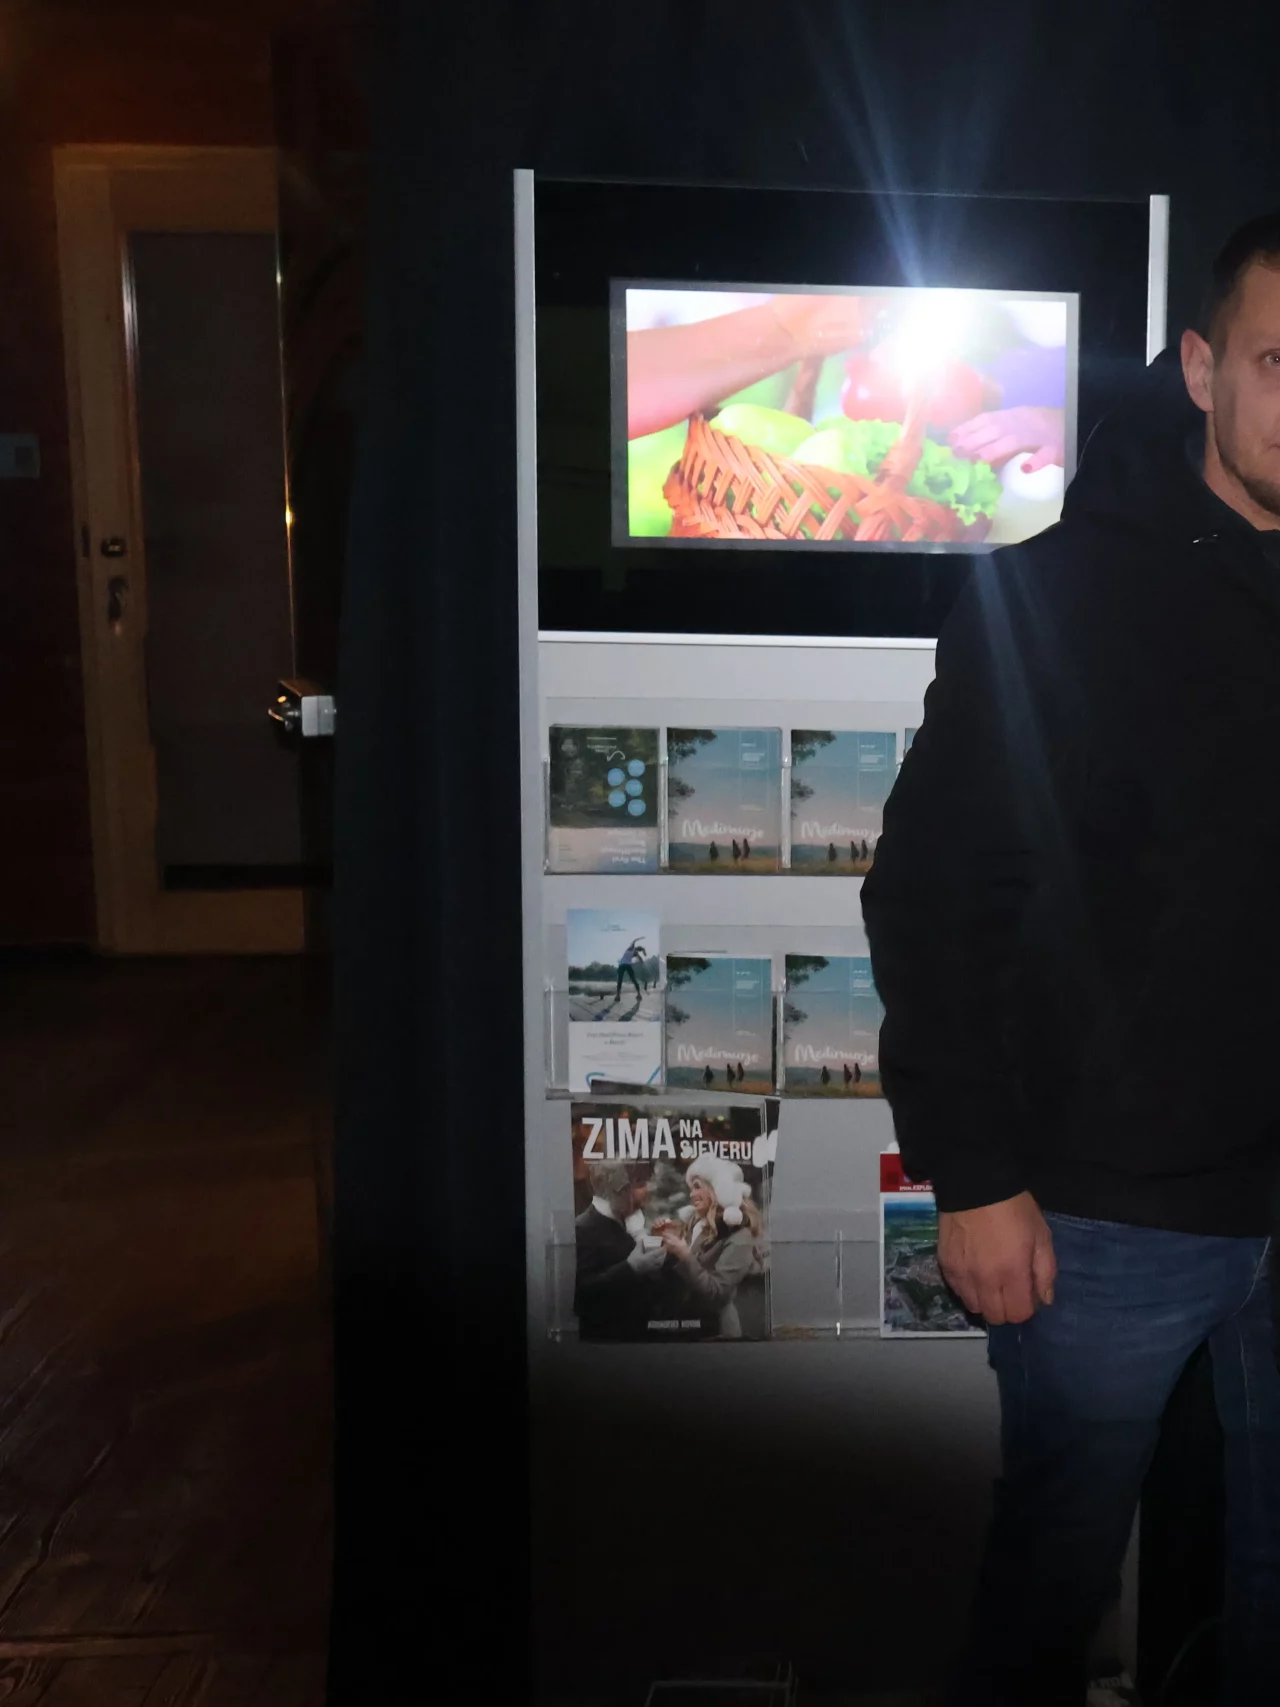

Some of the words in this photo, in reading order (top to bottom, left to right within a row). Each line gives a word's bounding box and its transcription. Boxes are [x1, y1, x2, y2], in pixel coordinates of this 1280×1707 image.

[582, 1117, 676, 1160] ZIMA
[679, 1119, 702, 1139] NA
[679, 1140, 753, 1161] SJEVERU
